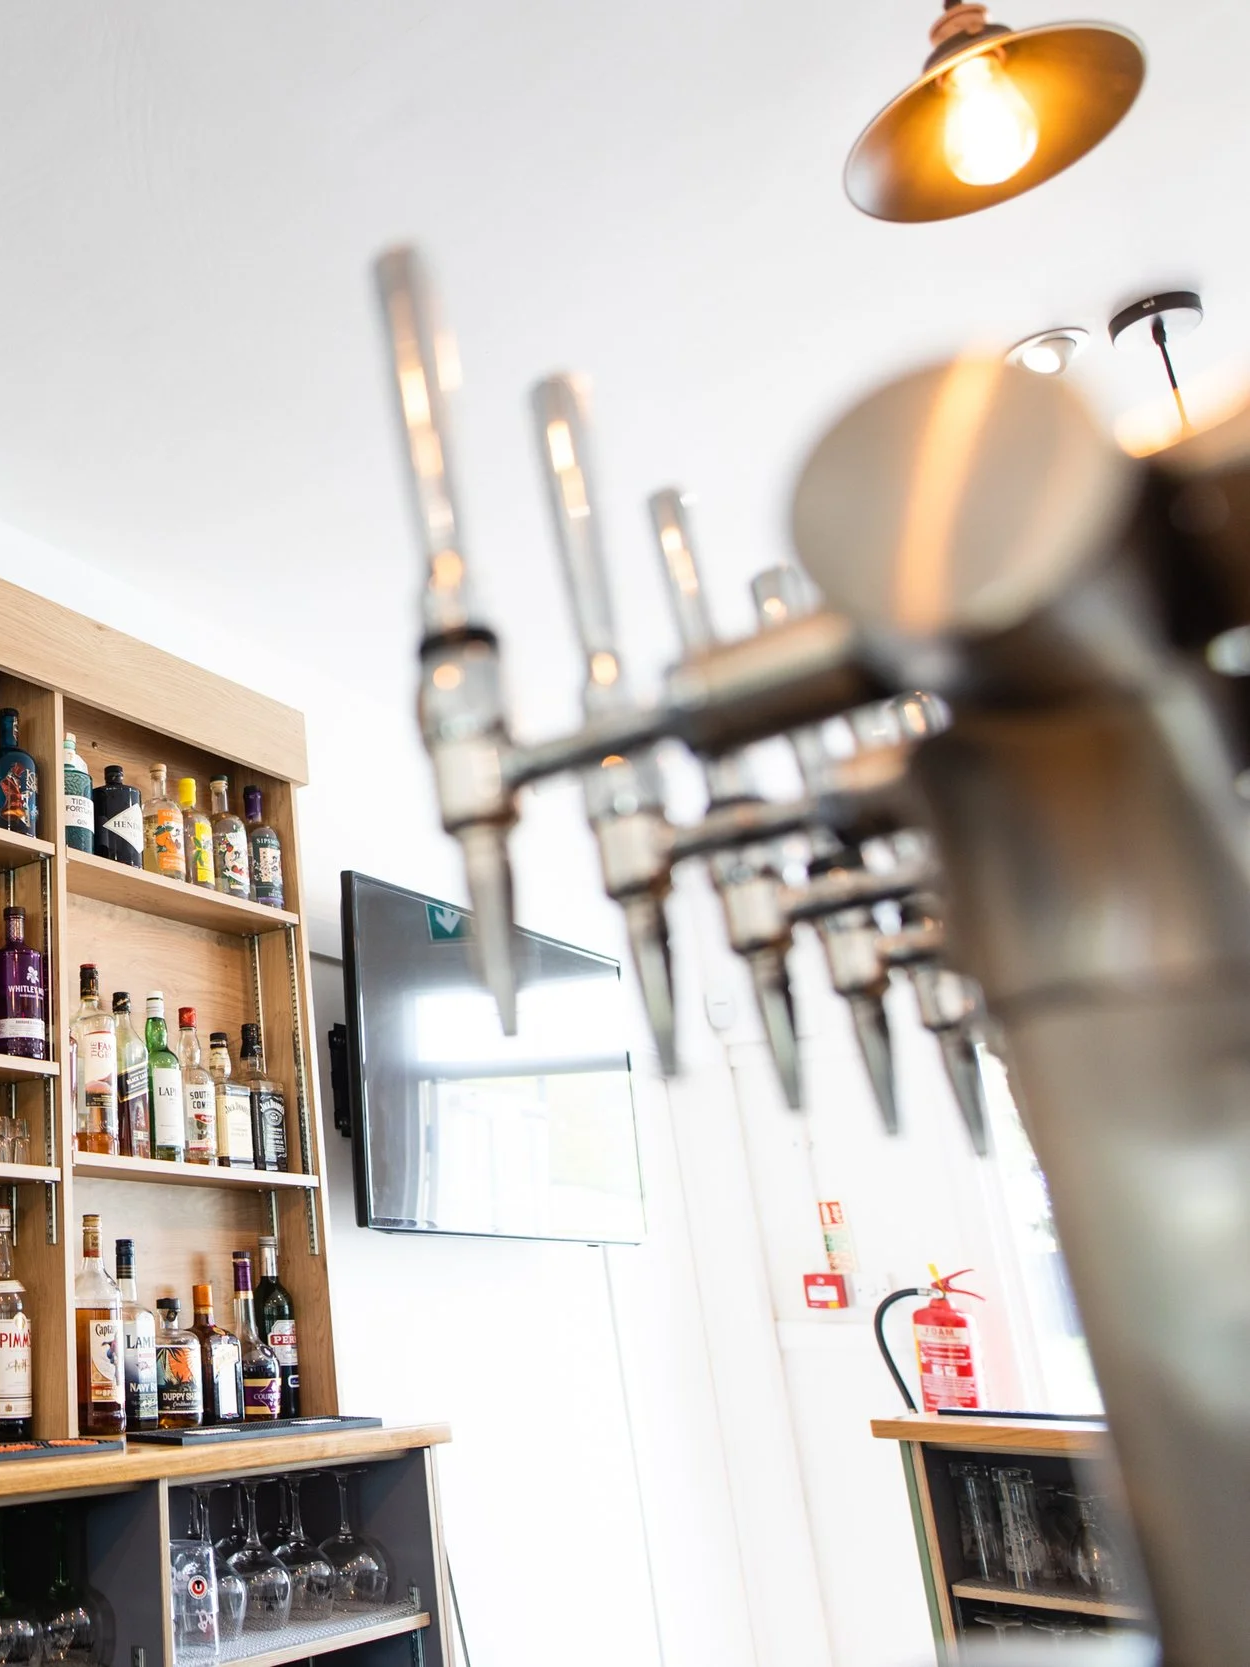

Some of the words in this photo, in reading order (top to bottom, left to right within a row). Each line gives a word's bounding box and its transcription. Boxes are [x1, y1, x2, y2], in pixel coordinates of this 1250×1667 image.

[7, 985, 38, 994] WHITLEY
[925, 1327, 955, 1337] FOAM
[129, 1382, 149, 1393] NAVY
[162, 1391, 185, 1402] DUPPY
